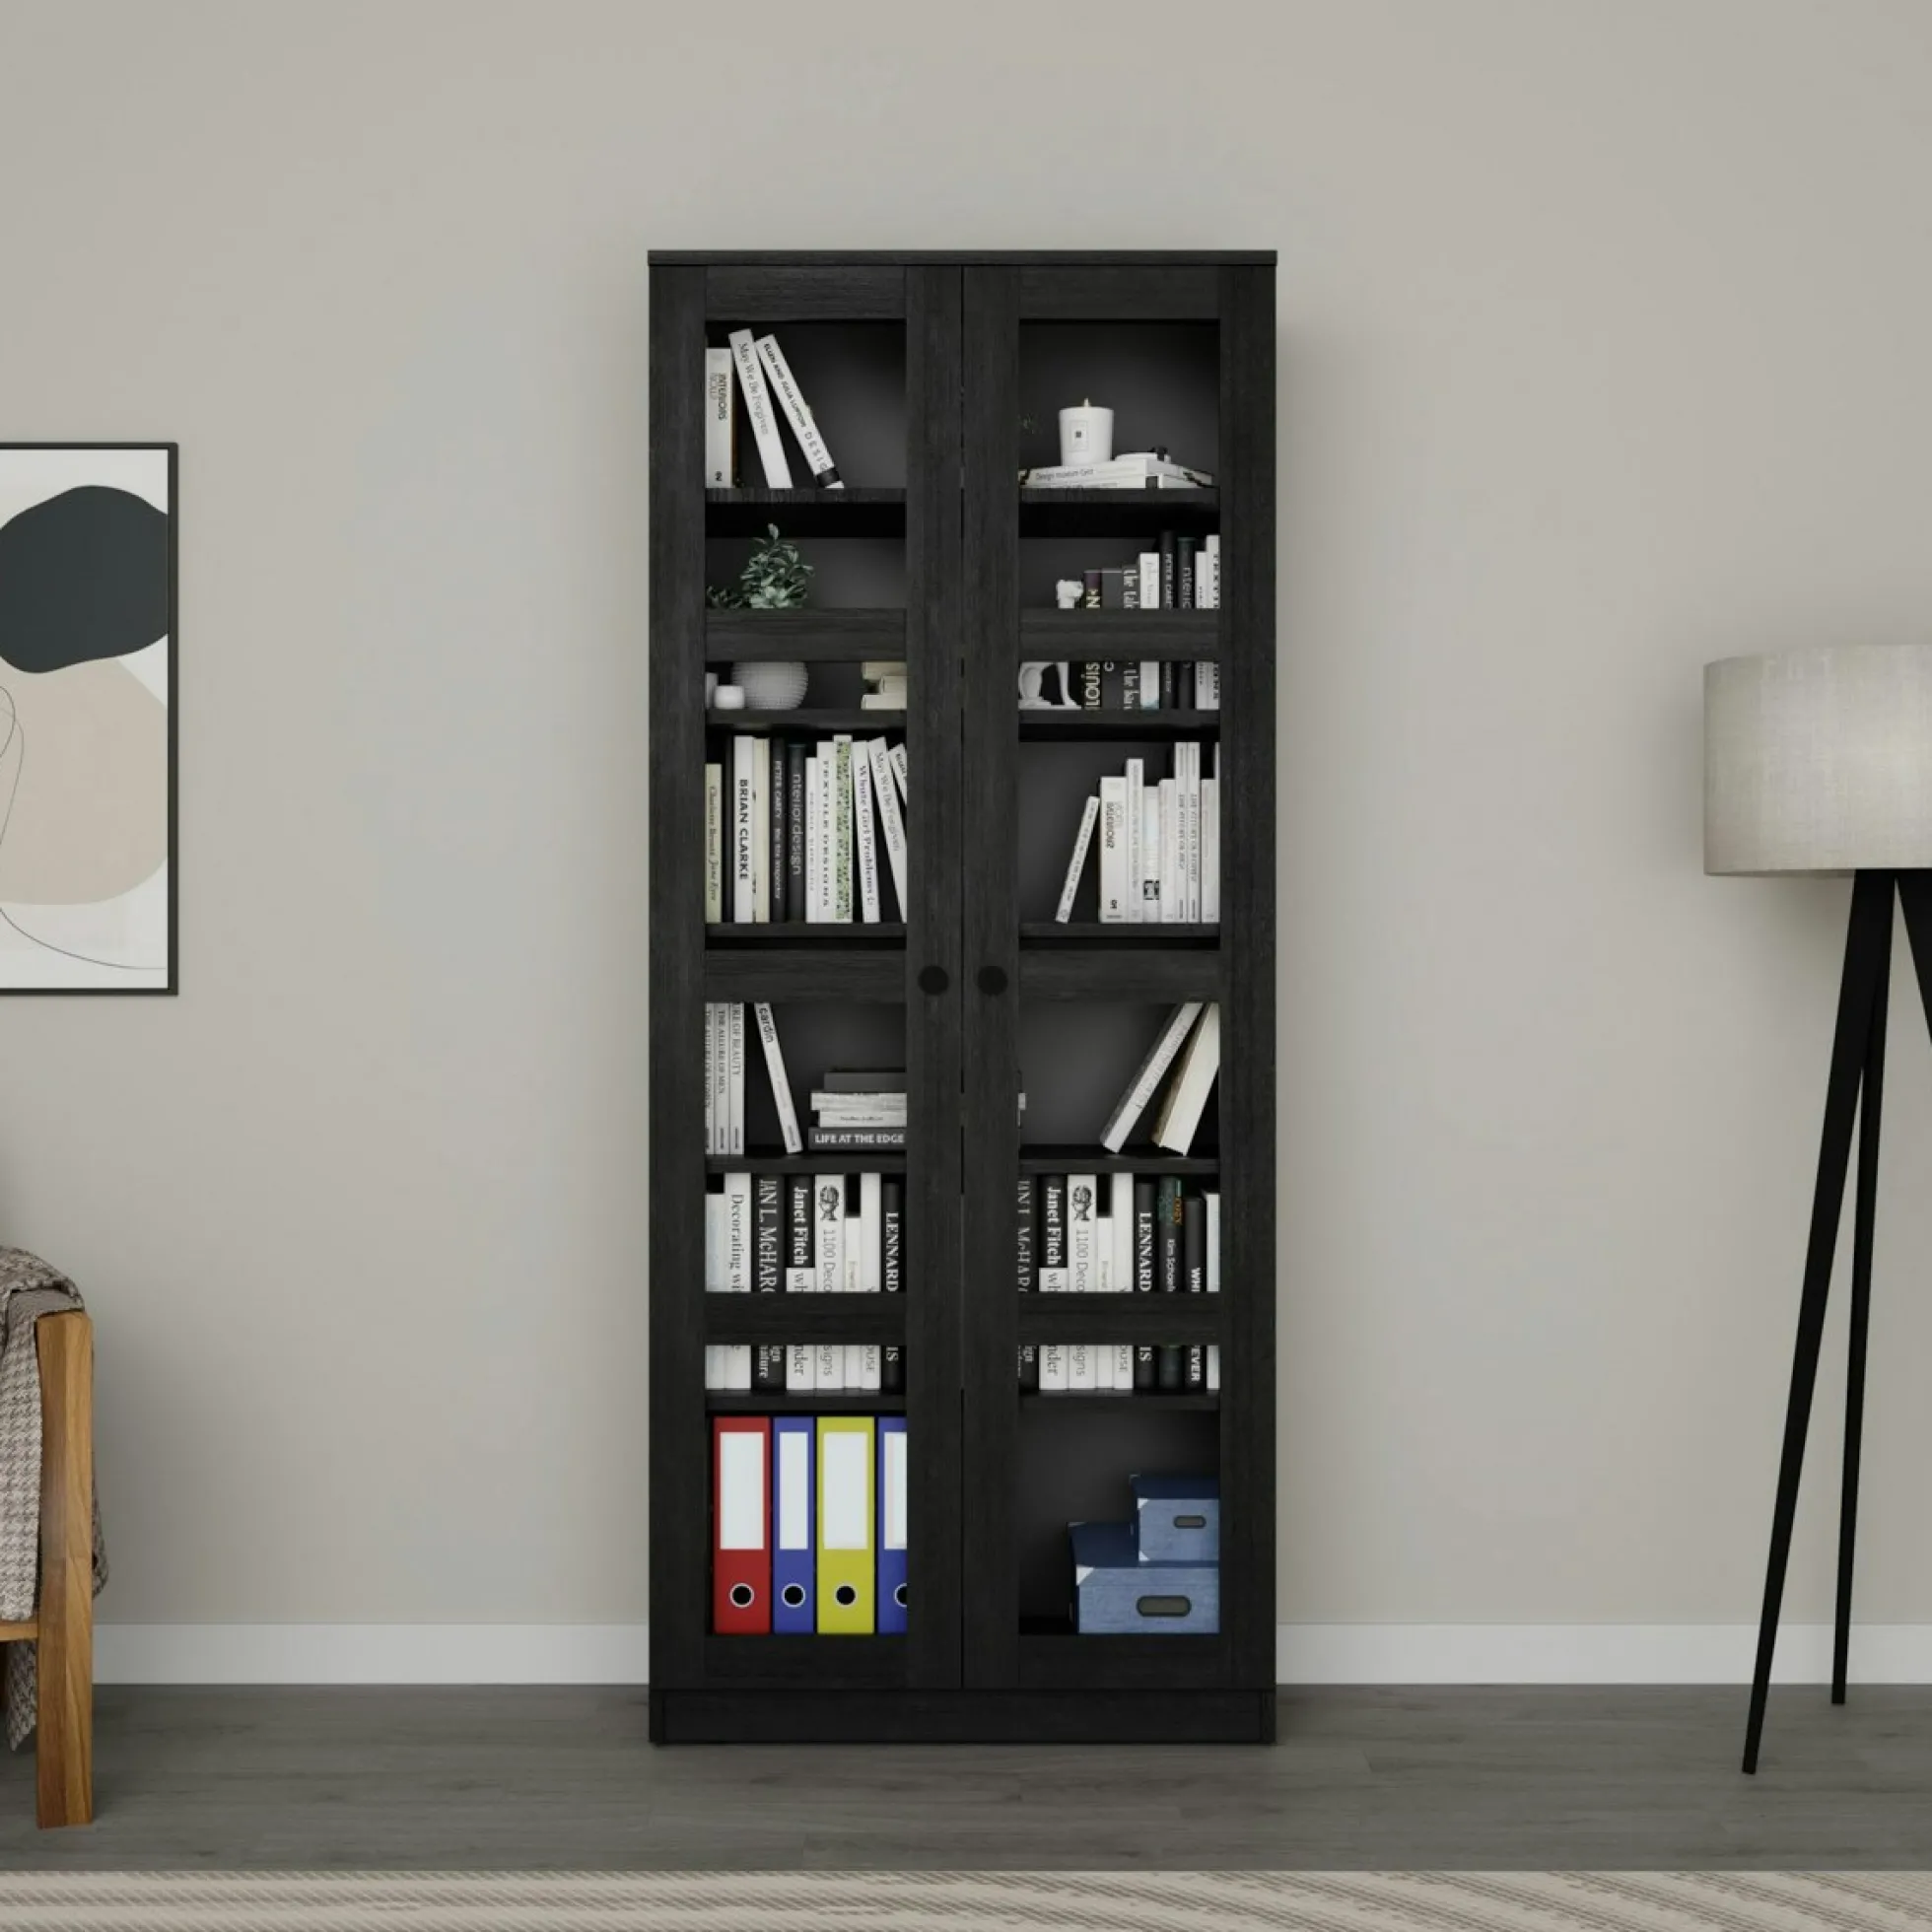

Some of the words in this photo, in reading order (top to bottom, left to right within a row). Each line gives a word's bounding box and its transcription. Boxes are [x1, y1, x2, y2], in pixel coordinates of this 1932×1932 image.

[739, 779, 749, 823] BRIAN
[739, 828, 749, 880] CLARKE
[814, 1134, 837, 1143] LIFE
[839, 1134, 852, 1143] AT
[855, 1134, 874, 1143] THE
[876, 1134, 905, 1143] EDGE
[793, 1186, 809, 1223] Janet
[1046, 1186, 1062, 1223] Janet
[729, 1194, 745, 1270] Decorating
[793, 1226, 809, 1266] Fitch
[823, 1228, 837, 1259] 1100
[1046, 1226, 1062, 1266] Fitch
[1075, 1228, 1089, 1259] 1100
[886, 1211, 899, 1292] LENNARD
[1138, 1211, 1152, 1292] LENNARD
[794, 1272, 808, 1292] wh
[823, 1262, 837, 1292] Deco
[1047, 1272, 1061, 1292] wh
[1075, 1262, 1089, 1292] Deco
[1190, 1268, 1201, 1292] WHI
[794, 1346, 808, 1376] nder
[820, 1346, 835, 1376] signs
[886, 1346, 899, 1362] IS
[1047, 1346, 1062, 1376] nder
[1072, 1346, 1087, 1376] signs
[1138, 1346, 1152, 1362] IS
